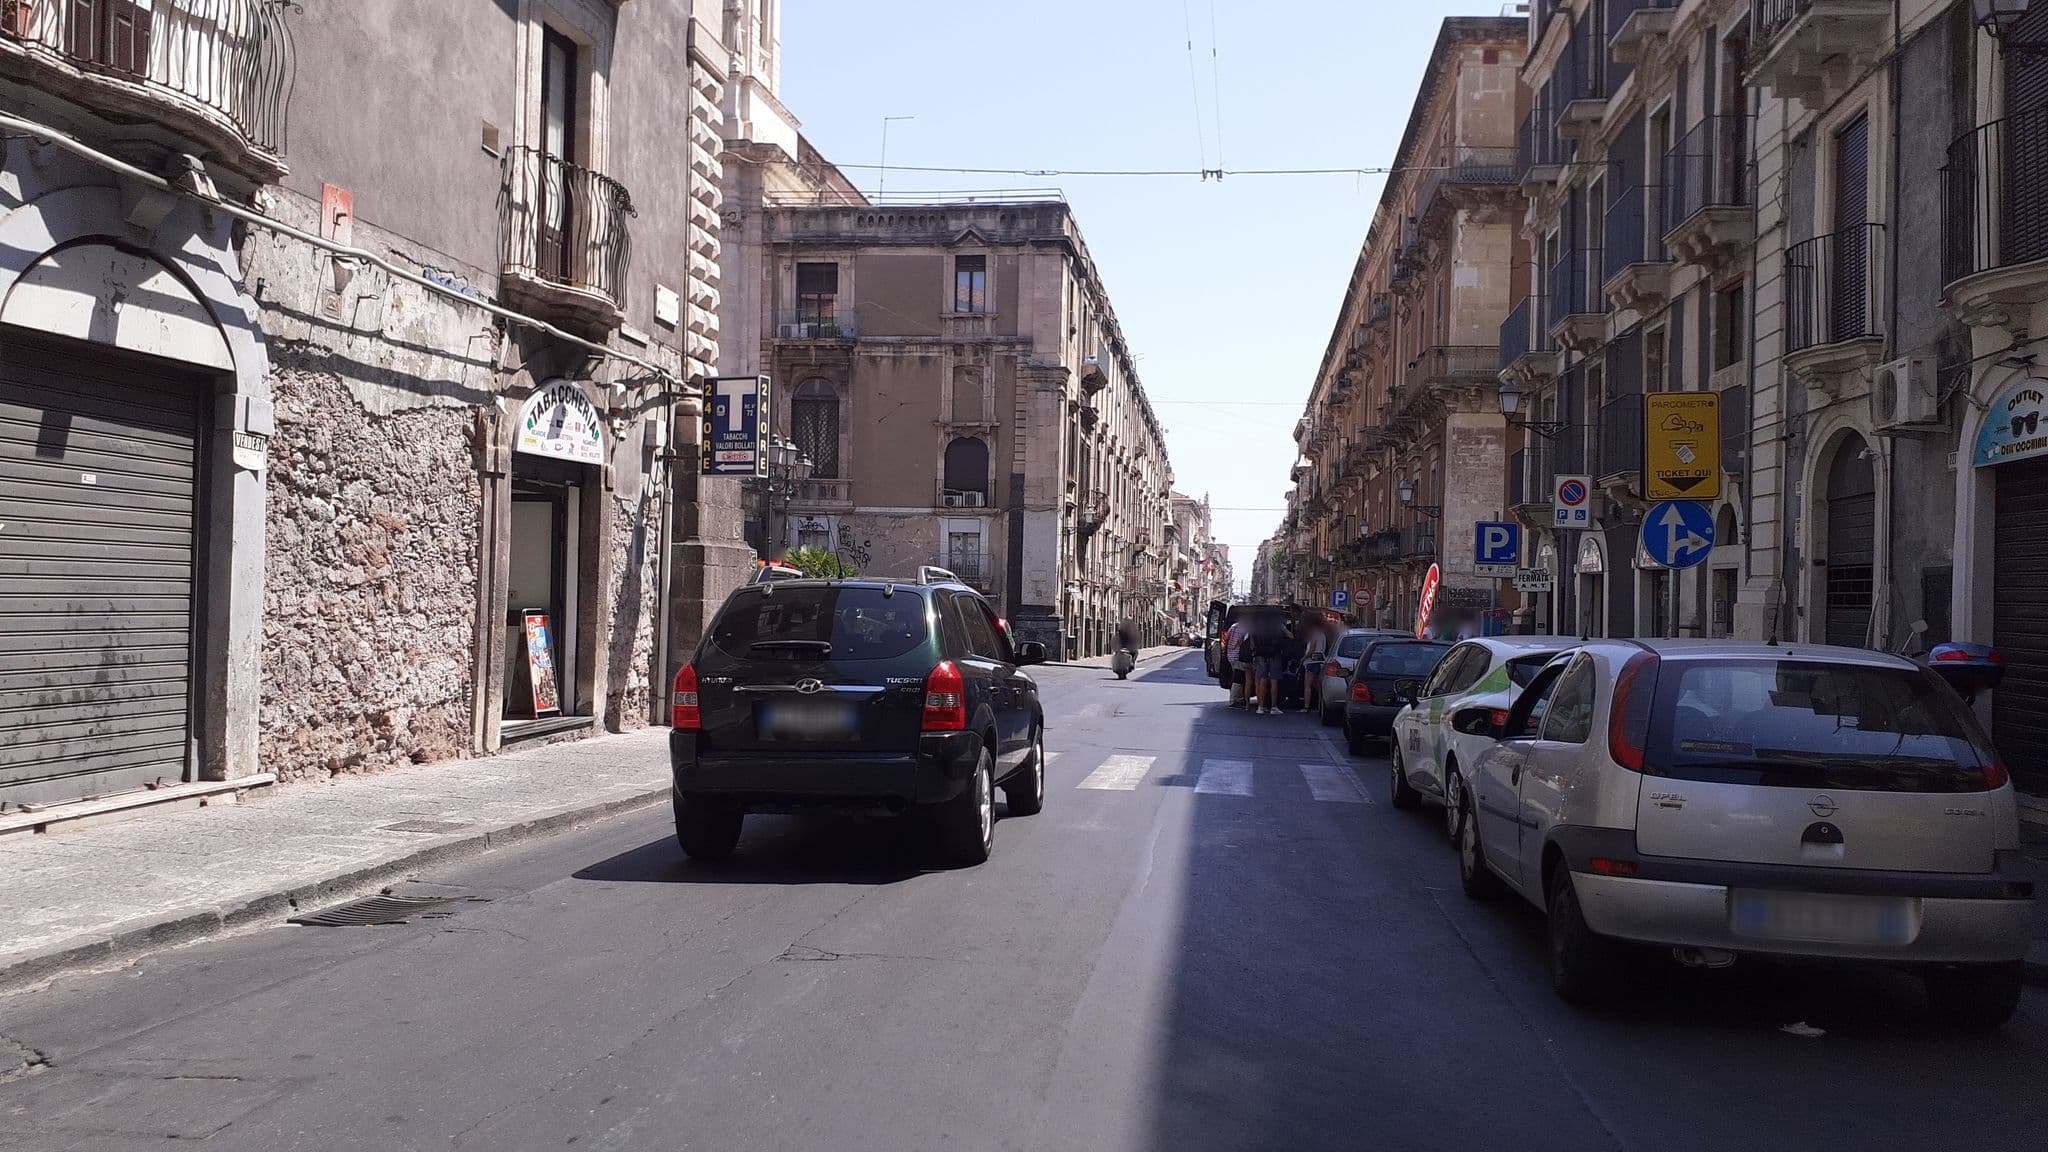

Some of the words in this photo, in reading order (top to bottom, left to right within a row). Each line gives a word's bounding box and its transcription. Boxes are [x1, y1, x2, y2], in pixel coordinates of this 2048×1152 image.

[704, 384, 712, 414] 24
[761, 384, 767, 414] 24
[2008, 389, 2044, 411] OUTLET
[530, 385, 596, 438] TABACCHERIA
[235, 433, 264, 451] VENDESI
[703, 422, 712, 469] ORE
[735, 441, 756, 449] BOLLATI
[1656, 469, 1690, 477] TICKET
[1695, 469, 1711, 477] QUI
[1559, 511, 1566, 519] P
[1484, 527, 1509, 558] P
[1518, 574, 1549, 582] FERMATA
[1335, 592, 1346, 605] P
[1649, 792, 1687, 802] OPEL
